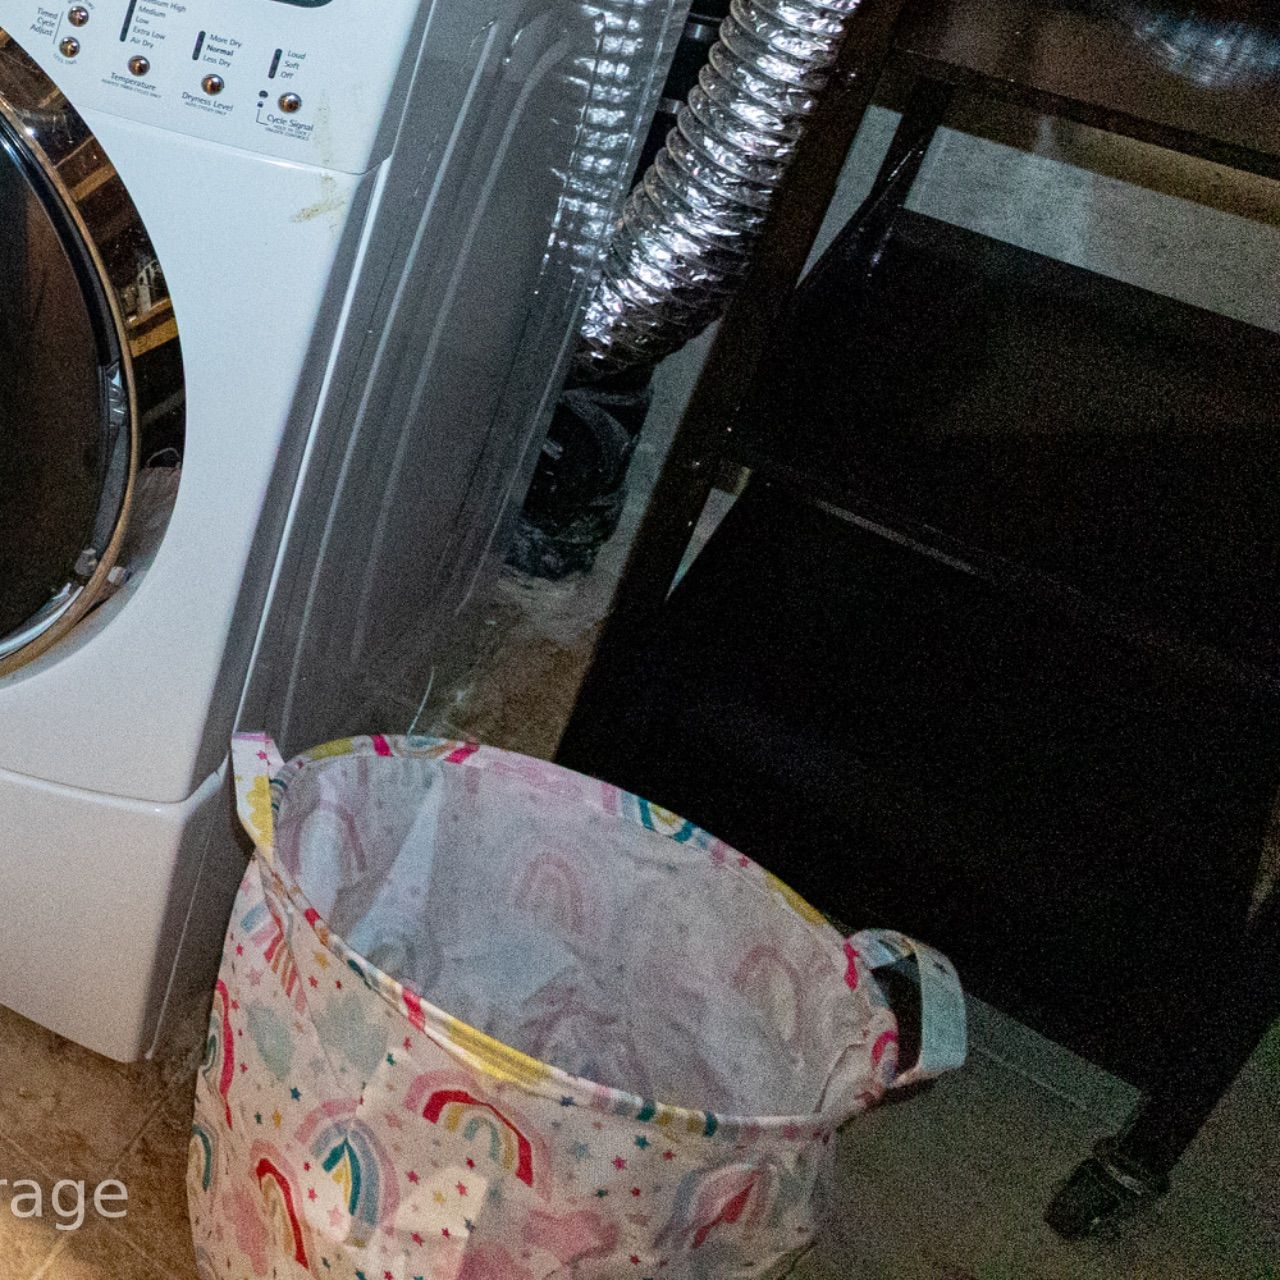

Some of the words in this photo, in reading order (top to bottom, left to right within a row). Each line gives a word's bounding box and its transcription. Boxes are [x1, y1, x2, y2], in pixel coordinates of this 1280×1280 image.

[37, 6, 59, 20] Timed
[139, 4, 167, 19] Medium
[170, 1, 188, 14] High
[36, 16, 57, 30] Cycle
[135, 15, 151, 26] Low
[29, 23, 54, 38] Adjust
[133, 25, 151, 38] Extra
[151, 29, 167, 41] Low
[129, 35, 142, 46] Air
[142, 39, 156, 51] Dry
[208, 32, 228, 46] More
[229, 36, 243, 49] Dry
[205, 43, 236, 58] Normal
[287, 49, 308, 61] Loud
[203, 53, 218, 65] Less
[218, 56, 233, 69] Dry
[284, 60, 301, 72] Soft
[110, 71, 157, 93] Temperature
[279, 70, 295, 80] Off
[181, 90, 213, 108] Dryness
[213, 98, 235, 113] Level
[266, 114, 289, 127] Cycle
[289, 118, 315, 133] Signal
